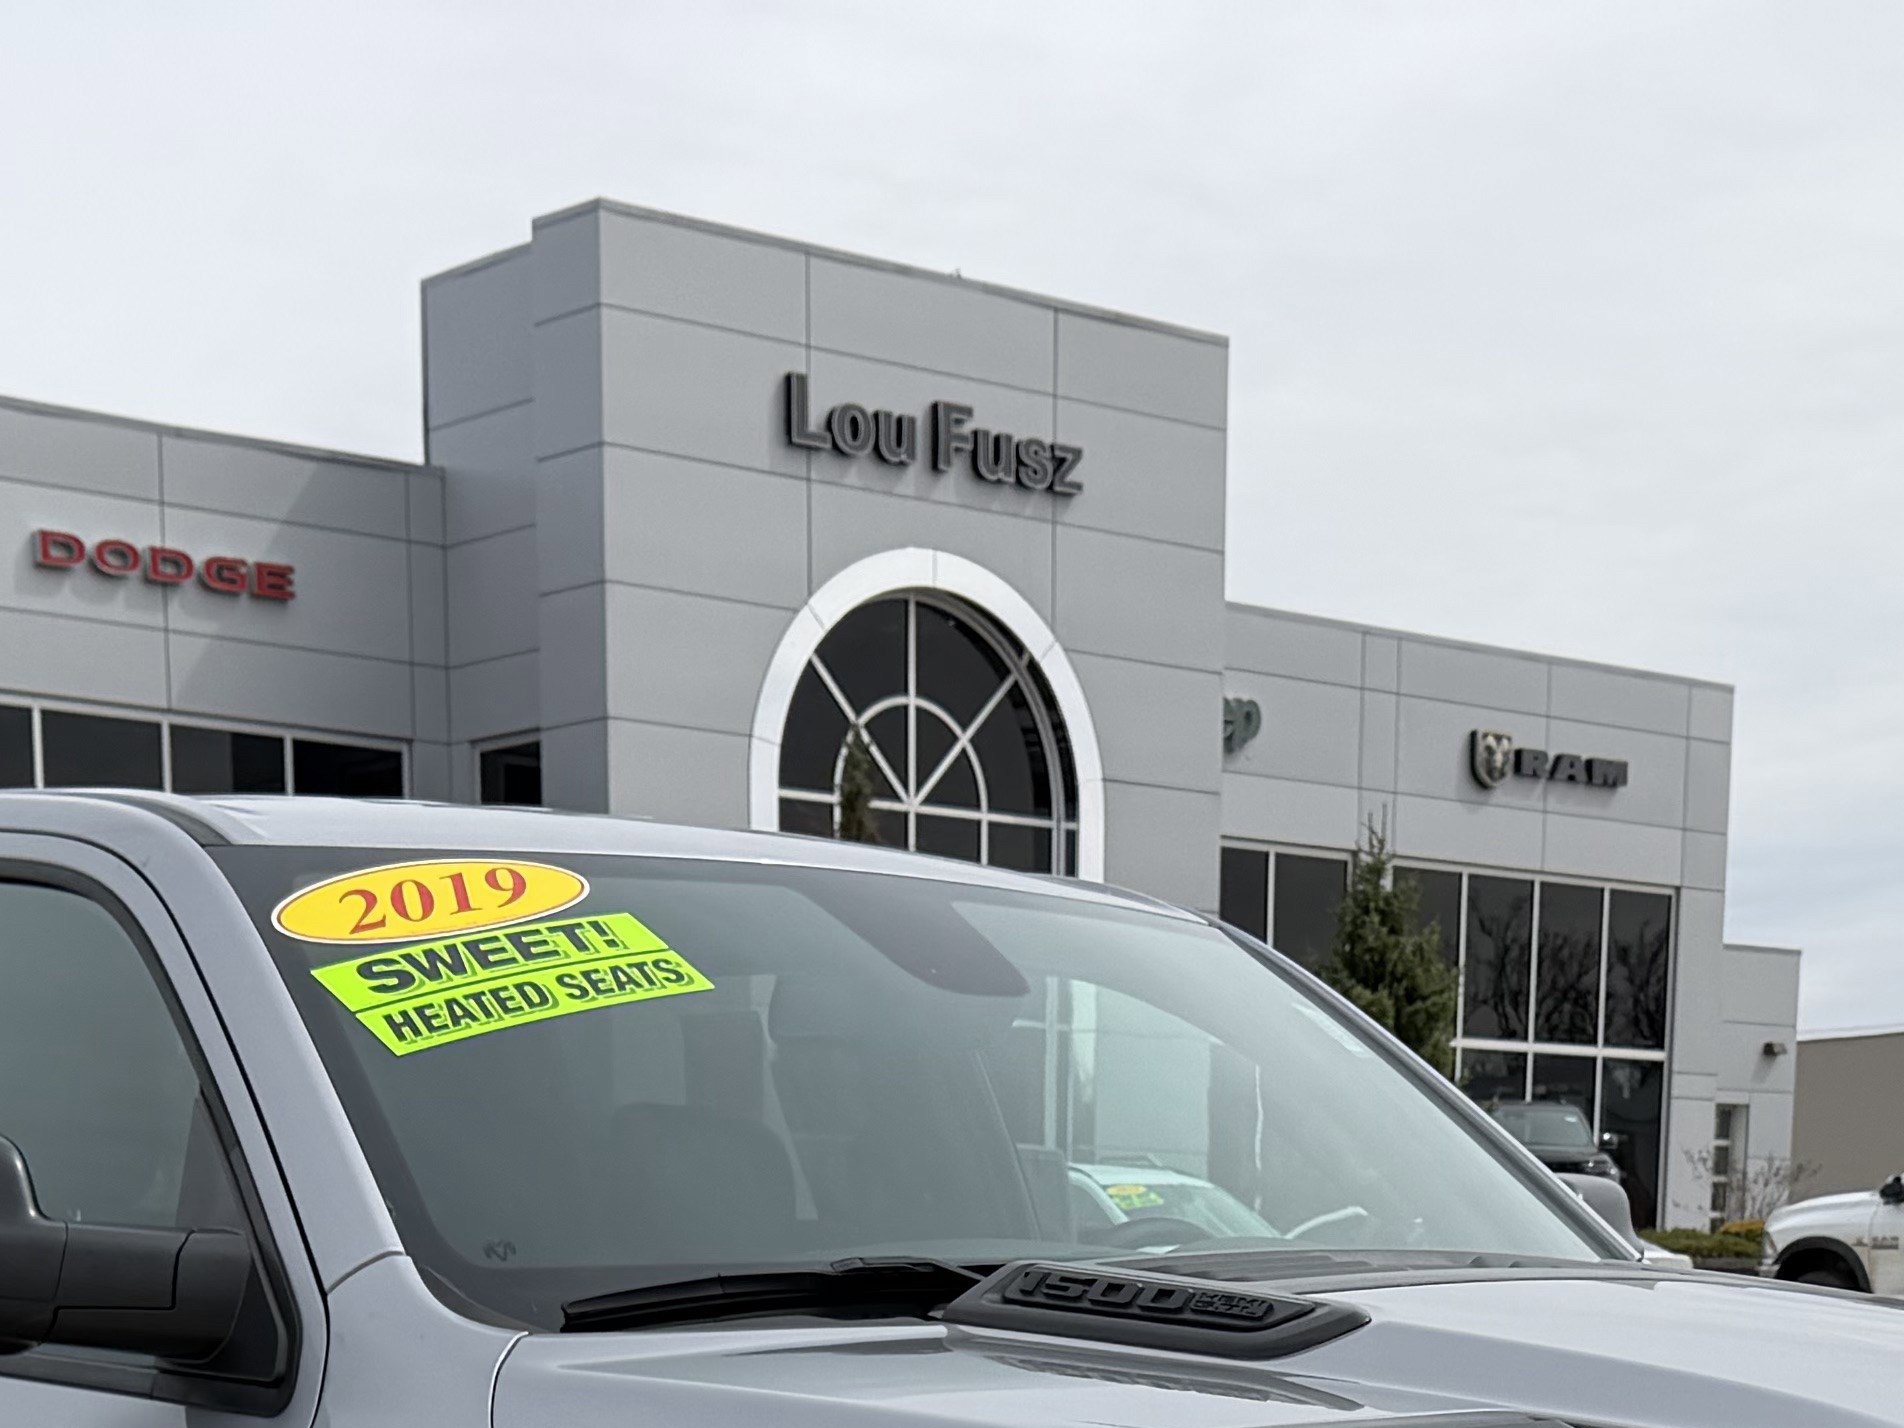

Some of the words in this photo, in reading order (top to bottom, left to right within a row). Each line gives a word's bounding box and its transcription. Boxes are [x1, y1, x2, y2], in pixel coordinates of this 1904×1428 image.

[784, 371, 917, 467] Lou
[929, 400, 1084, 494] Fusz
[31, 529, 296, 602] DODGE
[1512, 747, 1629, 788] RAM
[337, 867, 527, 935] 2019
[356, 920, 626, 994] SWEET!
[382, 980, 558, 1045] HEATED
[560, 957, 695, 1001] SEATS
[1013, 1269, 1193, 1315] 1500
